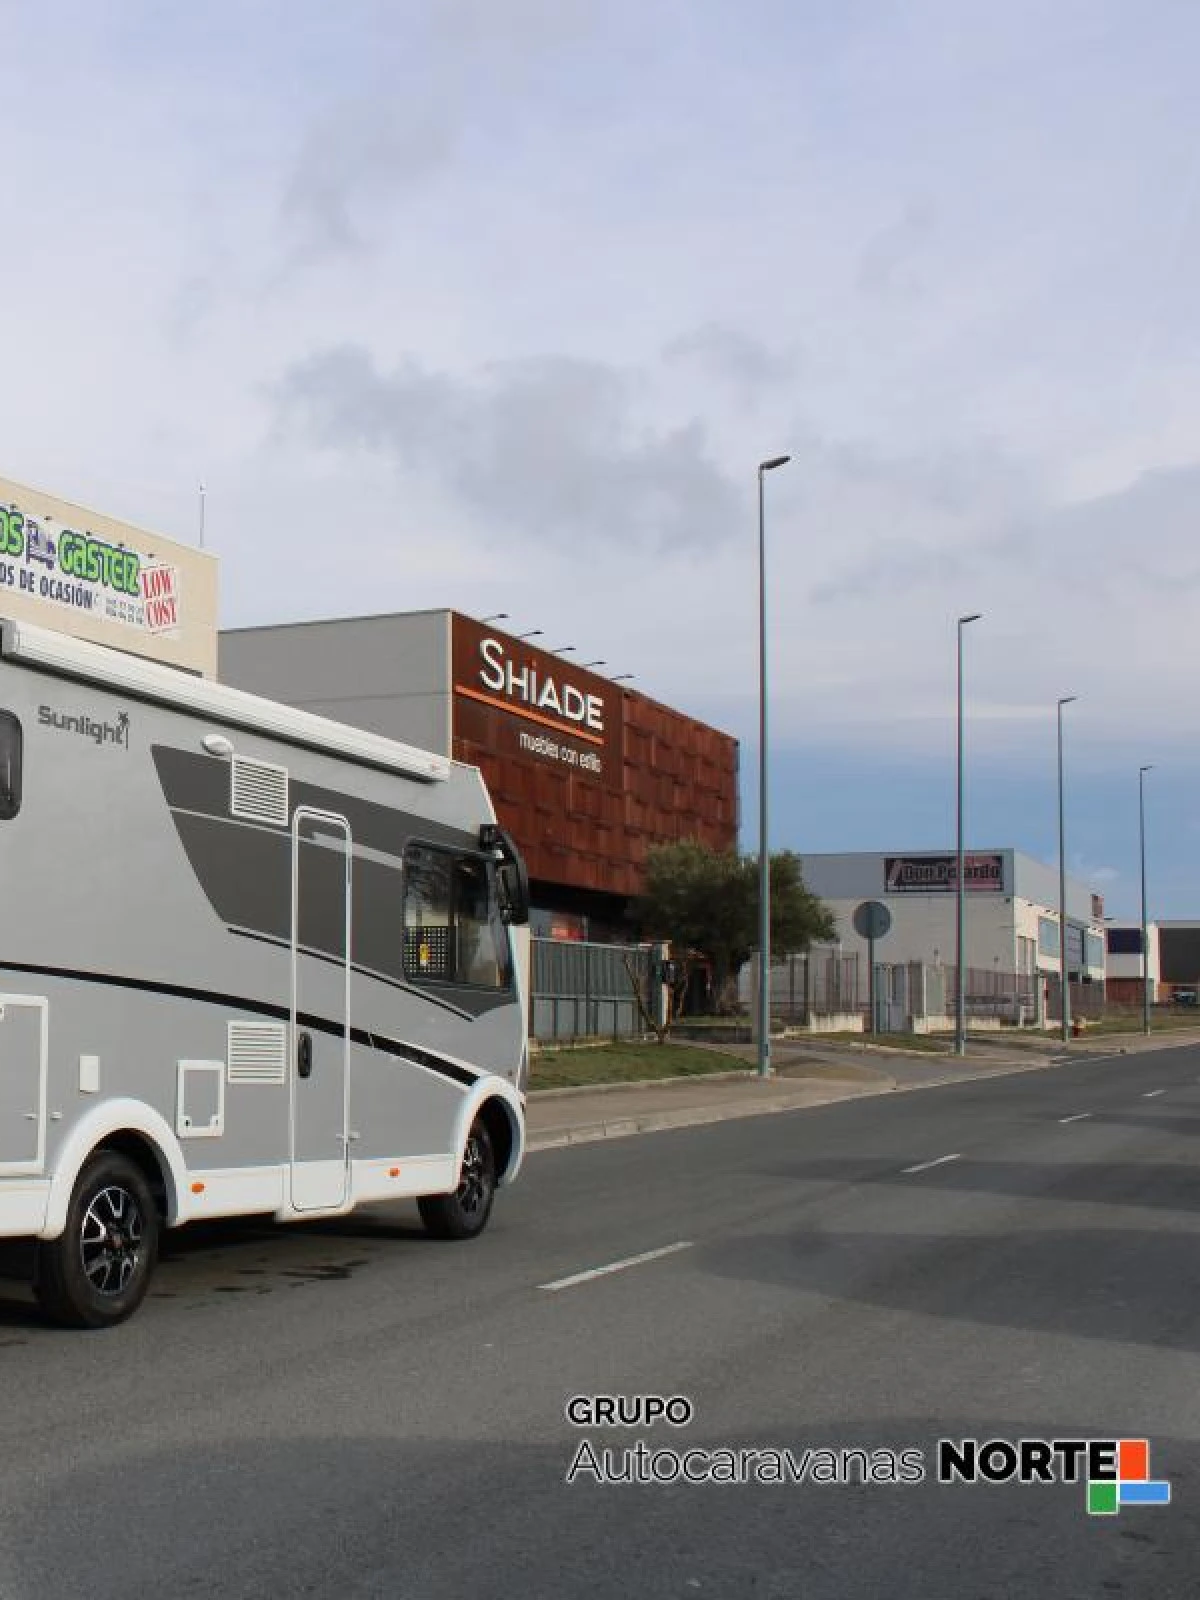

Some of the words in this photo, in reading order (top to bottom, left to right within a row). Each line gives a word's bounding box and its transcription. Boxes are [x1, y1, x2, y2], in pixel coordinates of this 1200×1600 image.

[19, 569, 34, 593] DE
[39, 575, 92, 608] OCASIÓN
[142, 570, 172, 598] LOW
[146, 598, 176, 628] COST
[38, 705, 124, 745] Sunlight
